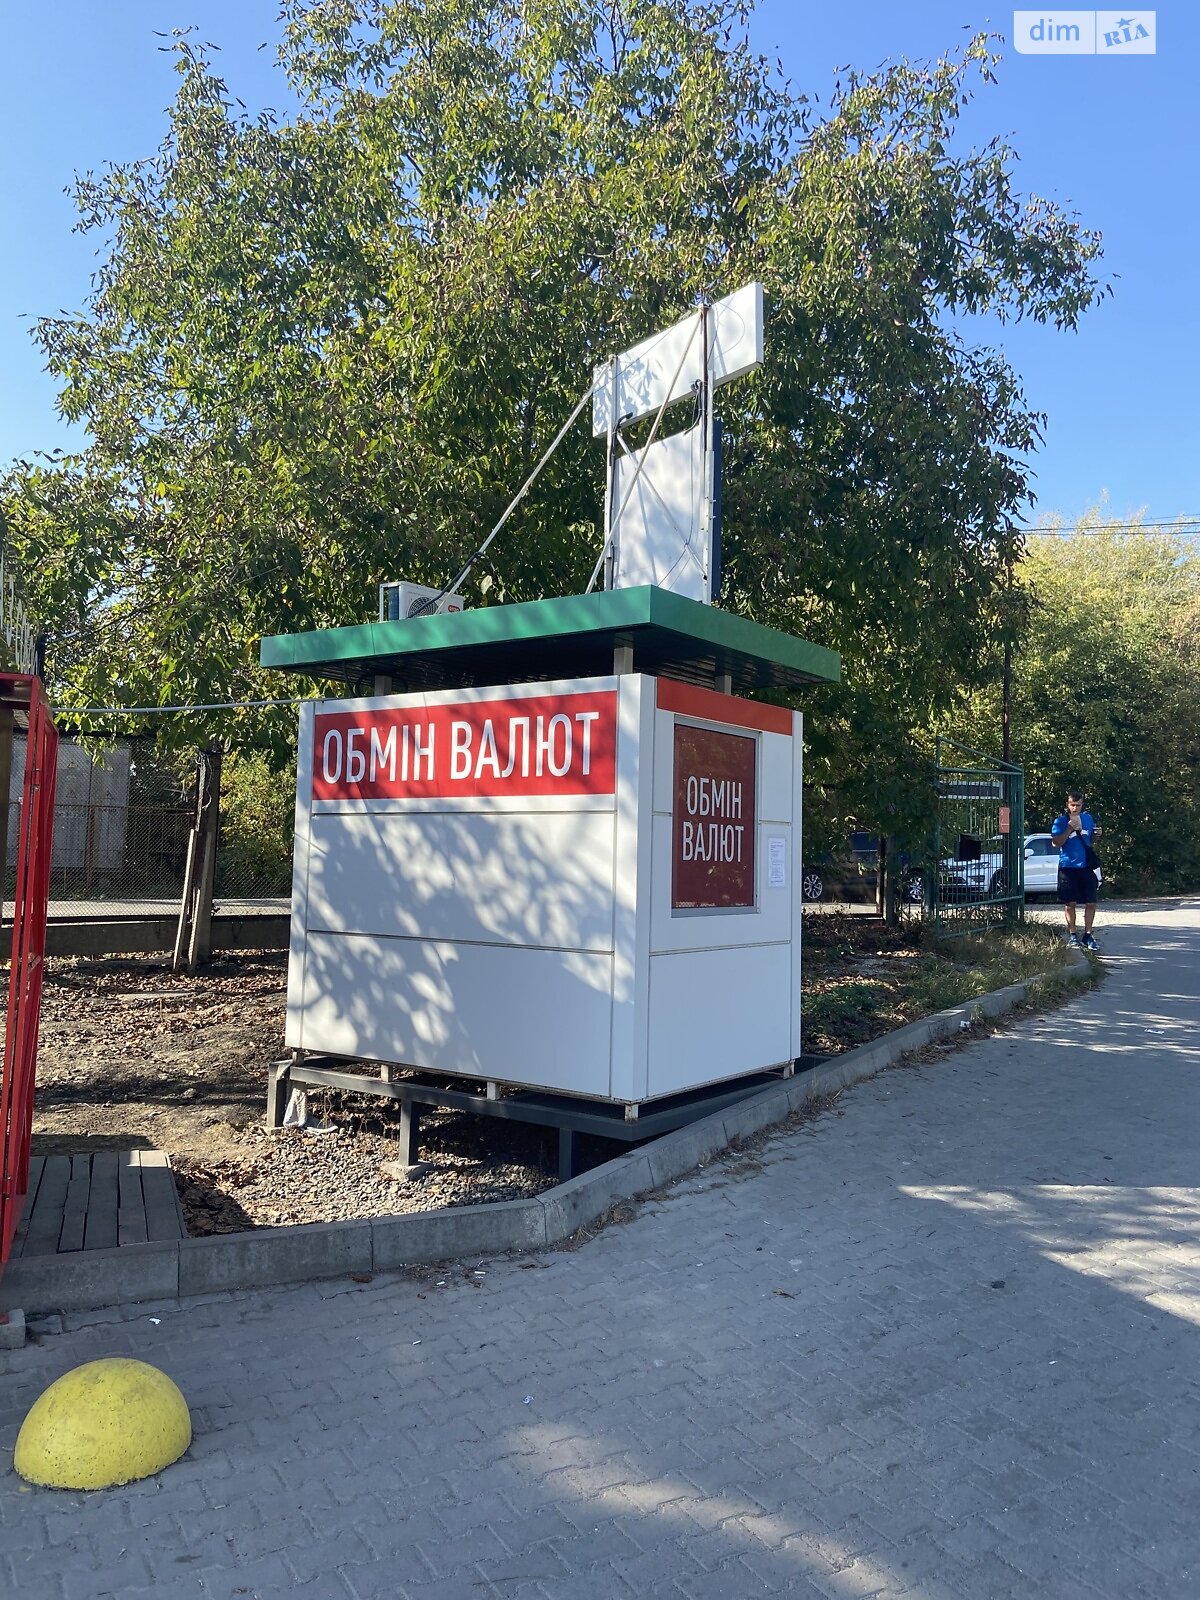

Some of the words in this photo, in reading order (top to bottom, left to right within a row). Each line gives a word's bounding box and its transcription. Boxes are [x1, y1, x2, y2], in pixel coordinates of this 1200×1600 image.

[322, 723, 435, 784] ОБМІН
[451, 712, 599, 780] ВАЛЮТ
[687, 776, 742, 819] ОБМІН
[682, 821, 744, 862] ВАЛЮТ
